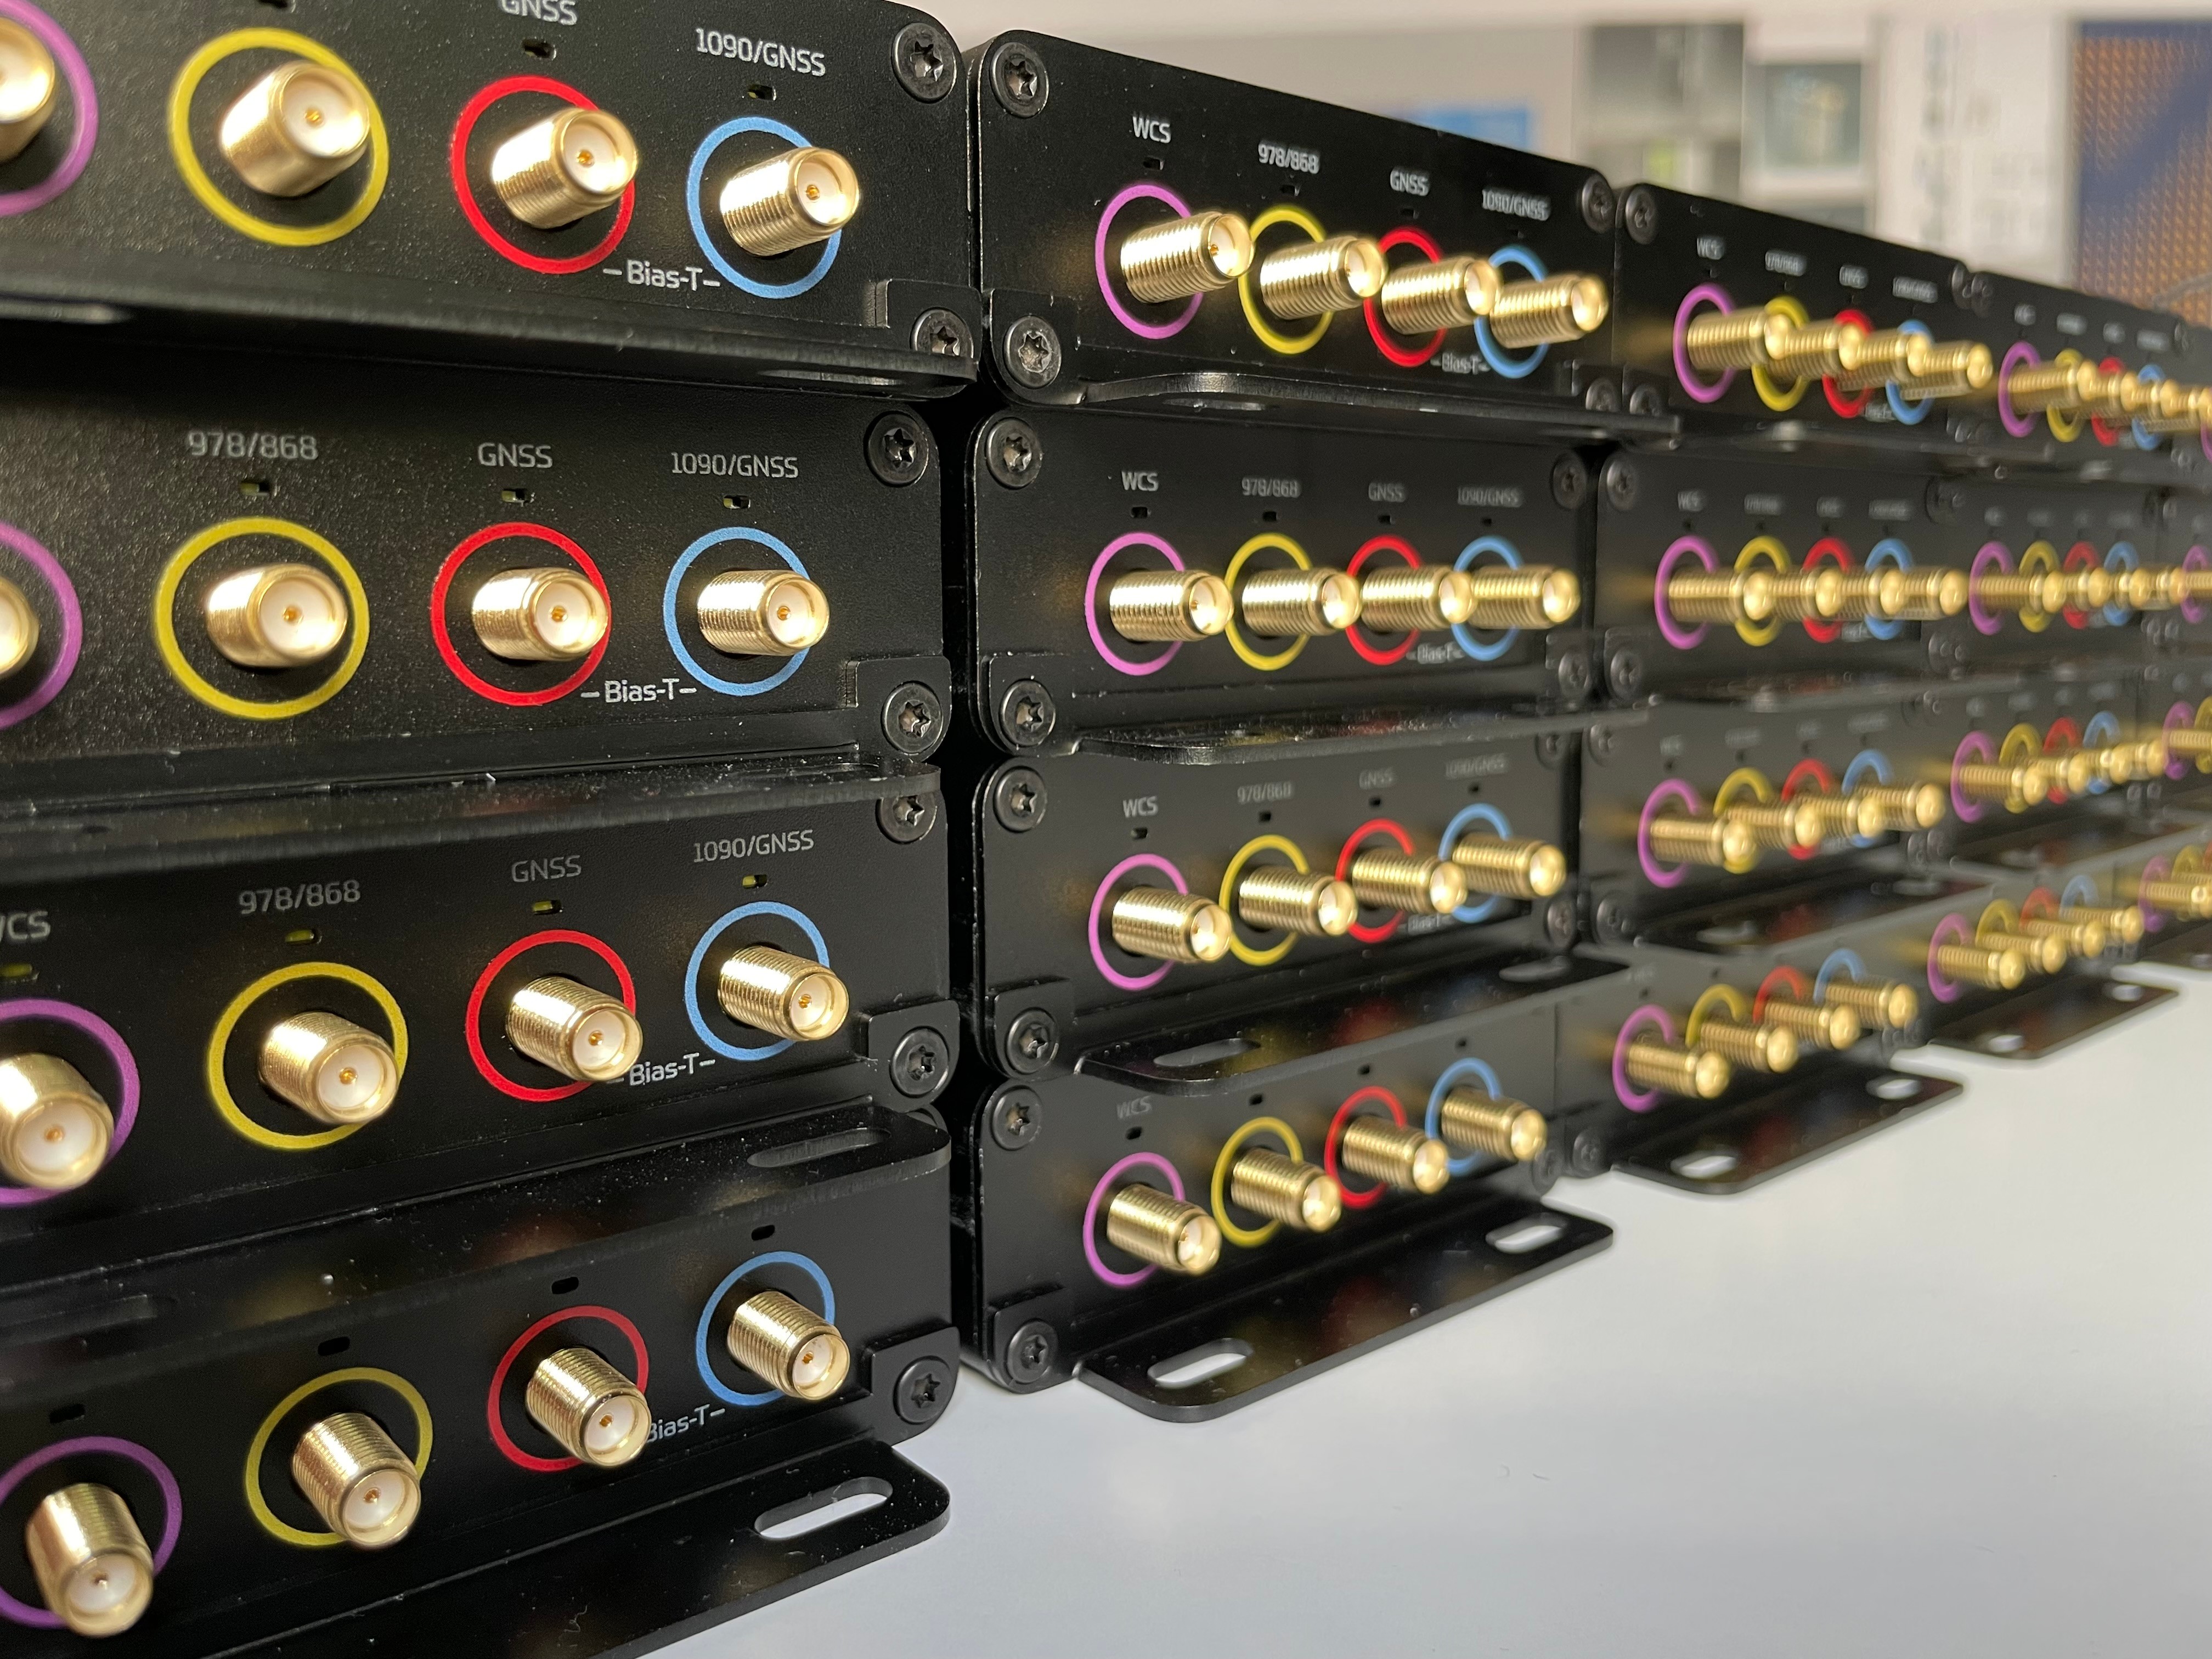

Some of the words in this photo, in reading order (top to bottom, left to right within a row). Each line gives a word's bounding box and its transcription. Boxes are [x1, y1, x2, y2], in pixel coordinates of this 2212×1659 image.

[500, 0, 578, 26] GNSS
[695, 27, 827, 77] 1090/GNSS
[1132, 115, 1171, 143] WCS
[1258, 143, 1319, 174] 978/868
[1390, 169, 1429, 196] GNSS
[1482, 189, 1551, 221] 1090/GNSS
[188, 431, 318, 461] 978/868
[478, 443, 552, 469] GNSS
[671, 452, 798, 478] 1090/GNSS
[1122, 471, 1159, 492] WCS
[1242, 477, 1301, 498] 978/868
[1368, 483, 1407, 503] GNSS
[1123, 797, 1158, 818] WCS
[693, 830, 814, 862] 1090/GNSS
[511, 855, 582, 883] GNSS
[239, 880, 361, 915] 978/868
[0, 911, 51, 940] CS
[1117, 1096, 1152, 1120] WCS
